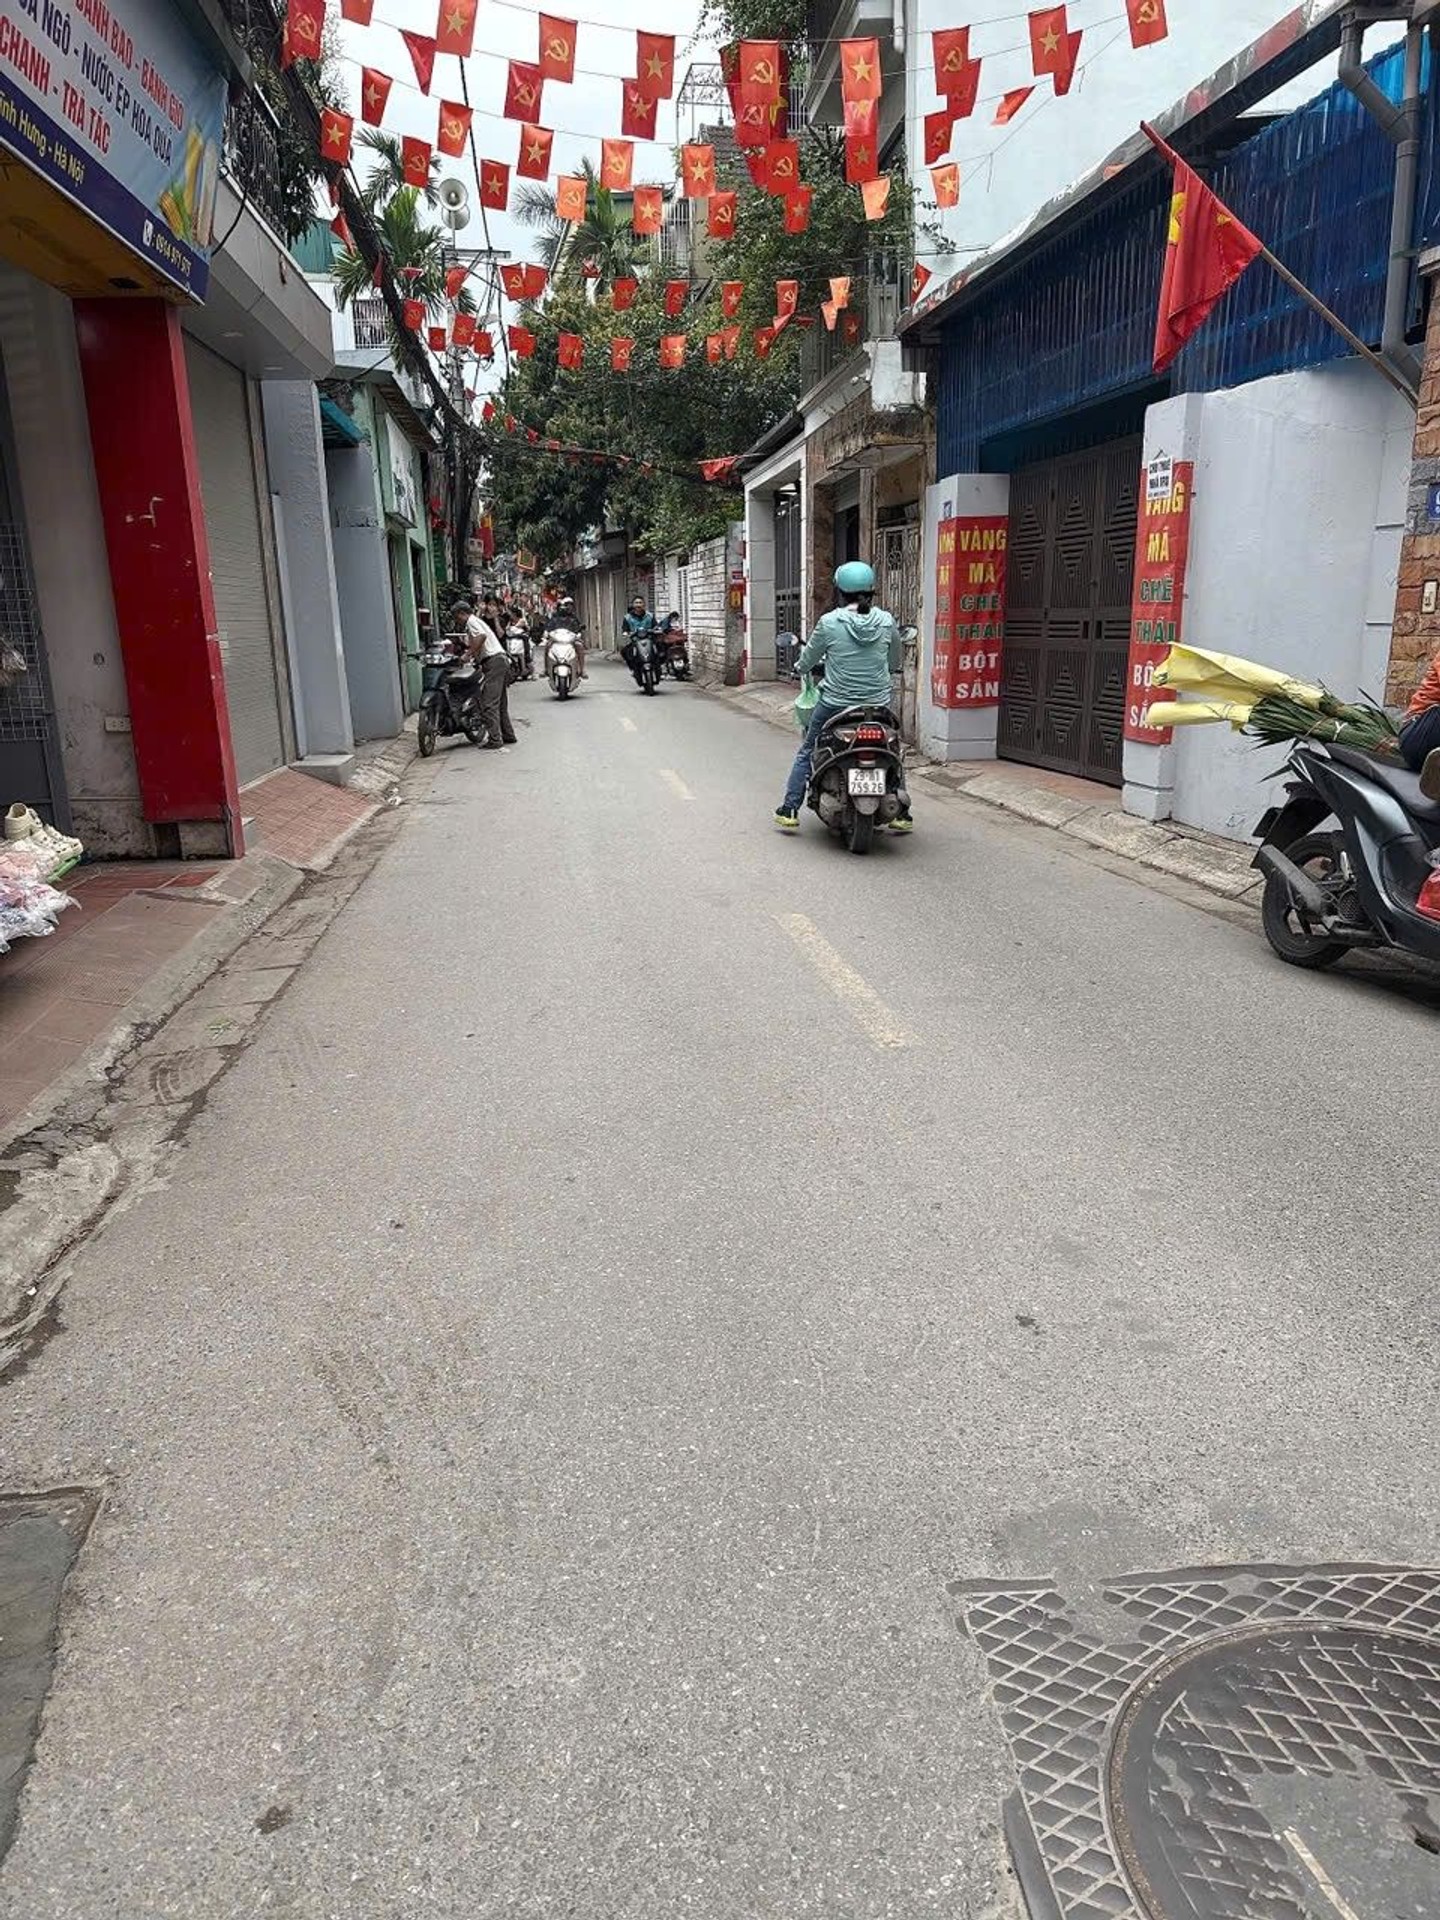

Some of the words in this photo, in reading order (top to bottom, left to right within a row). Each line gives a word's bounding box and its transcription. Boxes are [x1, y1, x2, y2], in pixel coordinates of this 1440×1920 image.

[42, 0, 71, 56] NGÔ
[81, 41, 114, 103] NƯỚC
[116, 76, 130, 118] ÉP
[131, 99, 151, 146] HOA
[62, 80, 85, 133] TRÀ
[960, 525, 1007, 552] VÀNG
[958, 650, 999, 674] BỘT
[1132, 660, 1154, 693] BỘ
[955, 678, 1000, 700] SẮN
